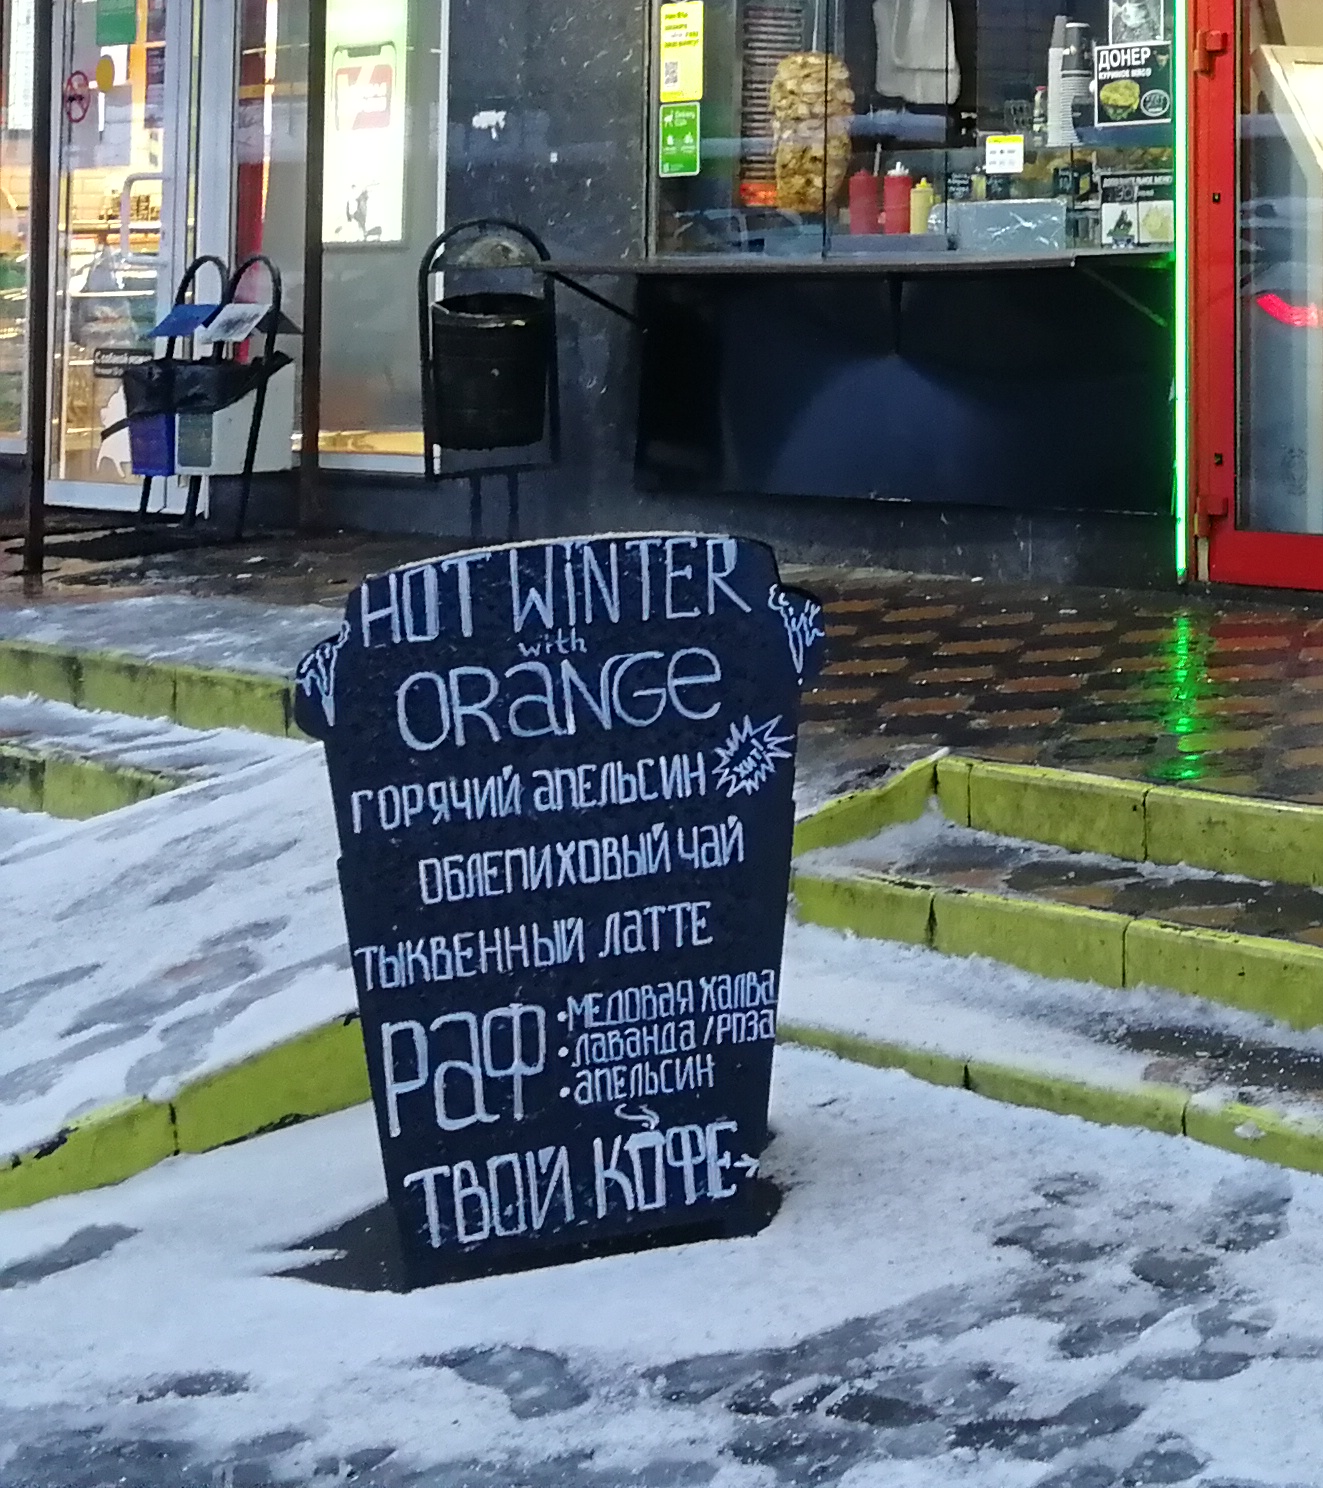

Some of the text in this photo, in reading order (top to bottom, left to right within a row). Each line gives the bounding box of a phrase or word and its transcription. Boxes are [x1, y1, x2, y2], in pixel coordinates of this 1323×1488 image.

[1098, 47, 1152, 72] ДОНЕР
[360, 551, 492, 647] HOT
[517, 626, 588, 658] with
[351, 764, 523, 834] ГОРЯЧИЙ
[418, 822, 672, 905] ОБЛЕПИХОВЫЙ
[354, 916, 585, 992] ТЫКВЕННЫЙ
[404, 1120, 739, 1249] ТВОЙ КОФЕ
